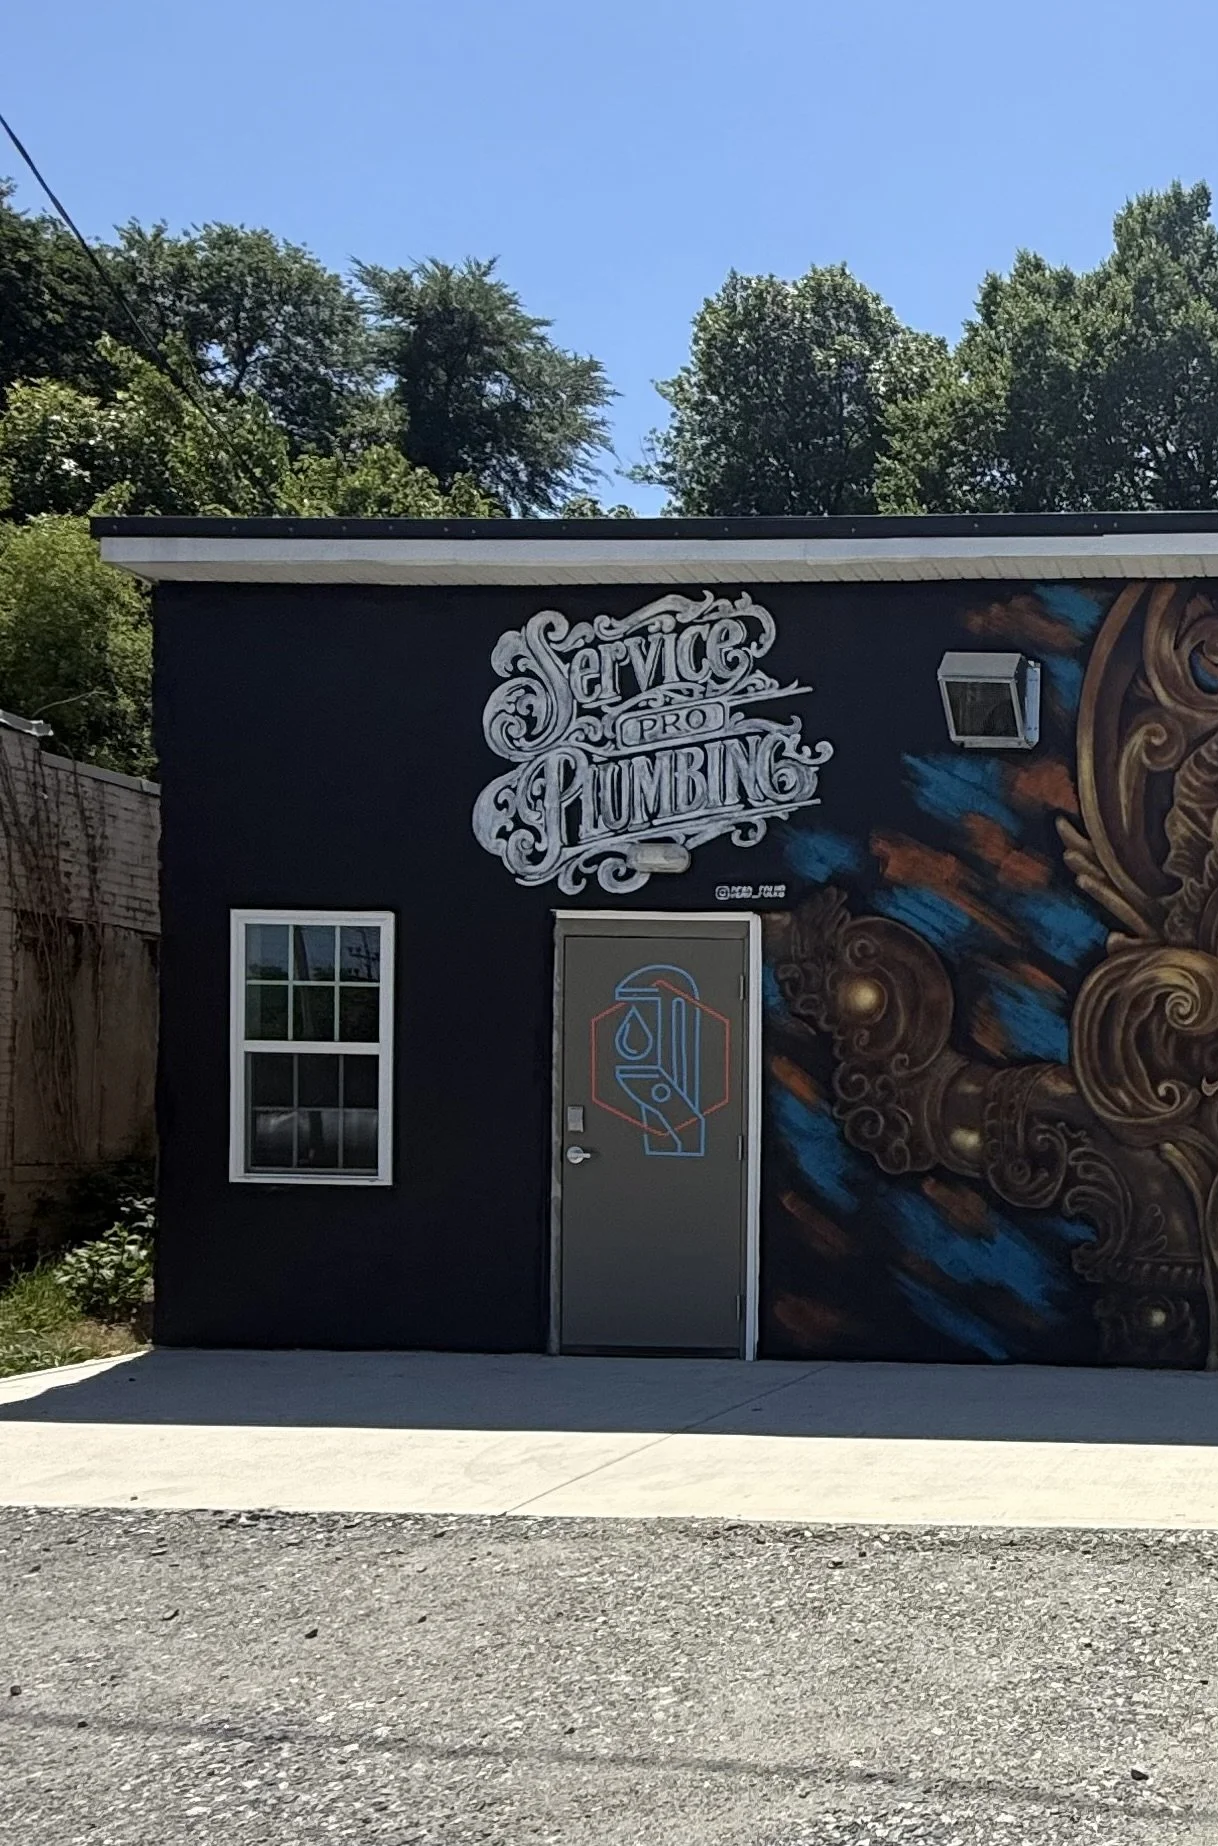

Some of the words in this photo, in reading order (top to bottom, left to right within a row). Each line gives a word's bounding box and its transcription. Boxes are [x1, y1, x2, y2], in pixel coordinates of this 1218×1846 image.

[484, 607, 752, 761] Service
[638, 707, 707, 741] PRO
[474, 734, 820, 878] PLUMBING
